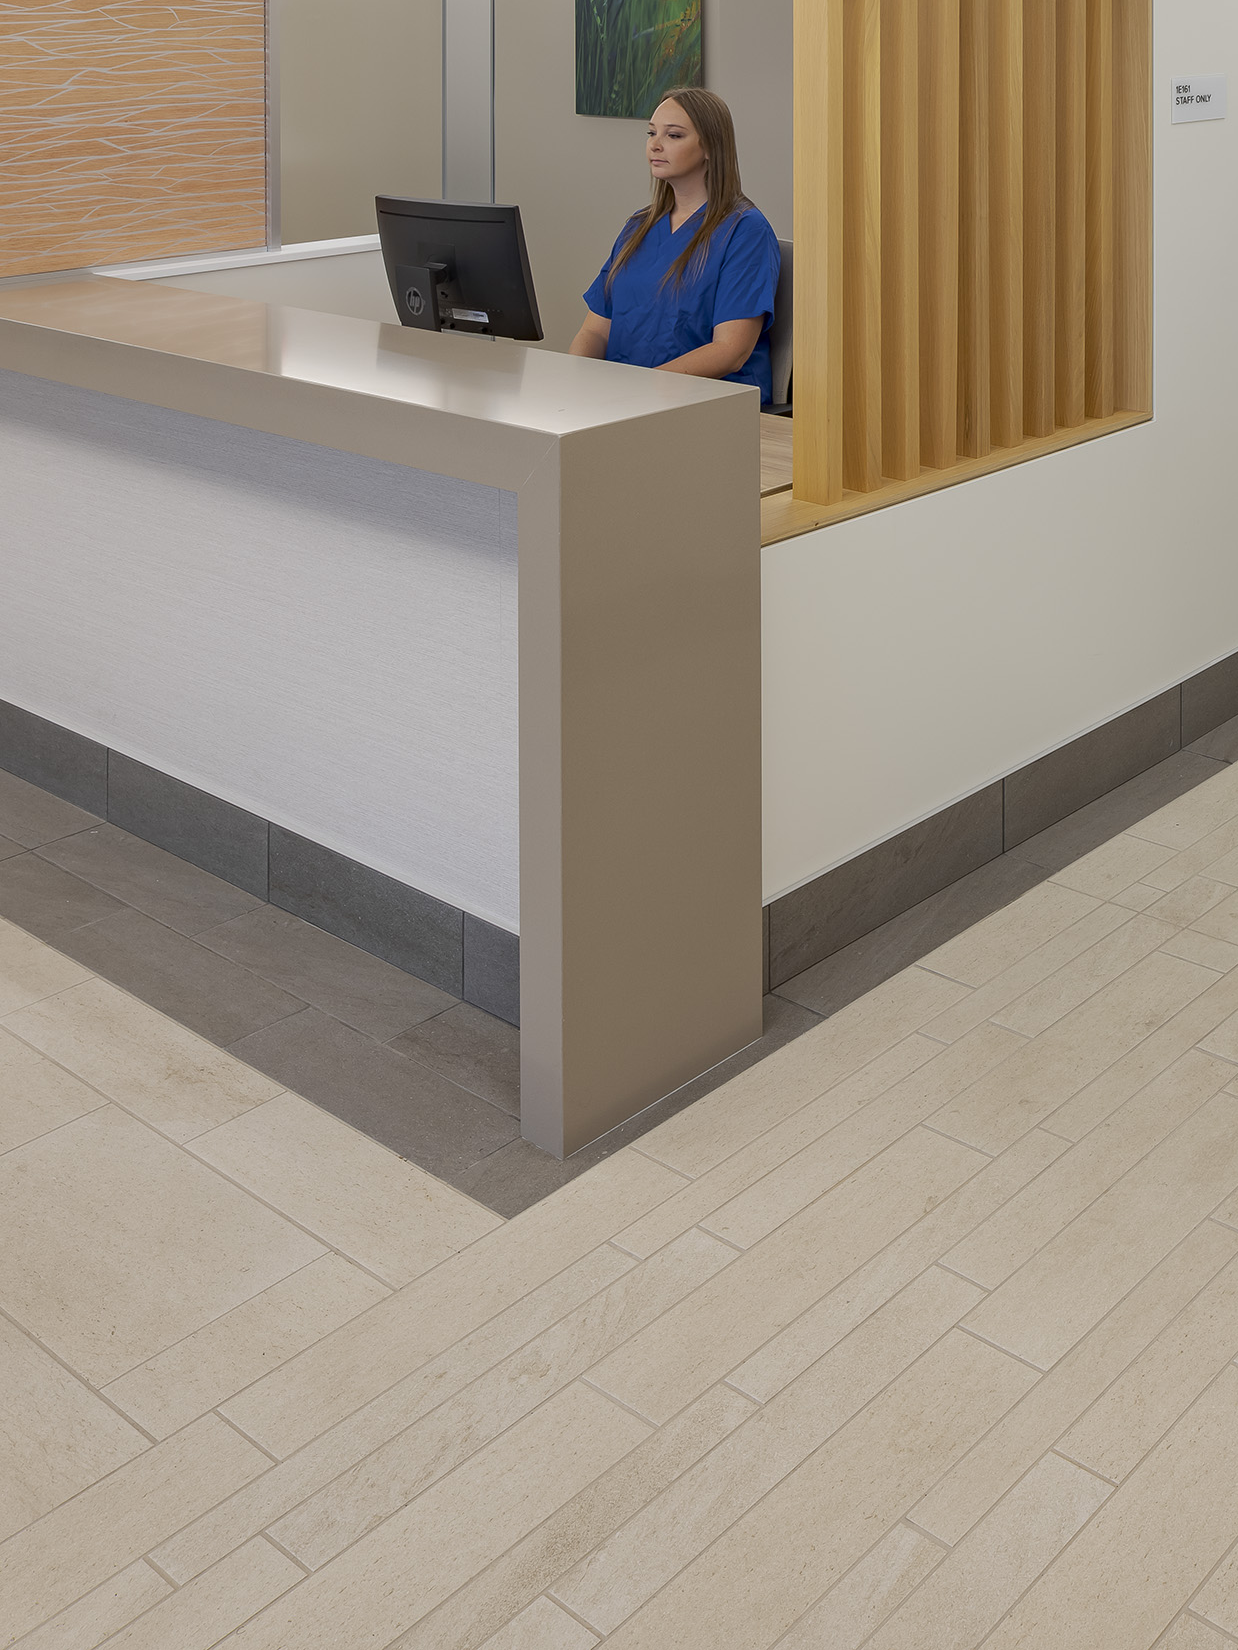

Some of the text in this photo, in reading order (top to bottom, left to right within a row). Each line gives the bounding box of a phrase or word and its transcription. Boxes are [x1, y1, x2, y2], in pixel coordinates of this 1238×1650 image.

[1175, 84, 1191, 94] 1E161
[1175, 94, 1212, 105] STAFF ONLY
